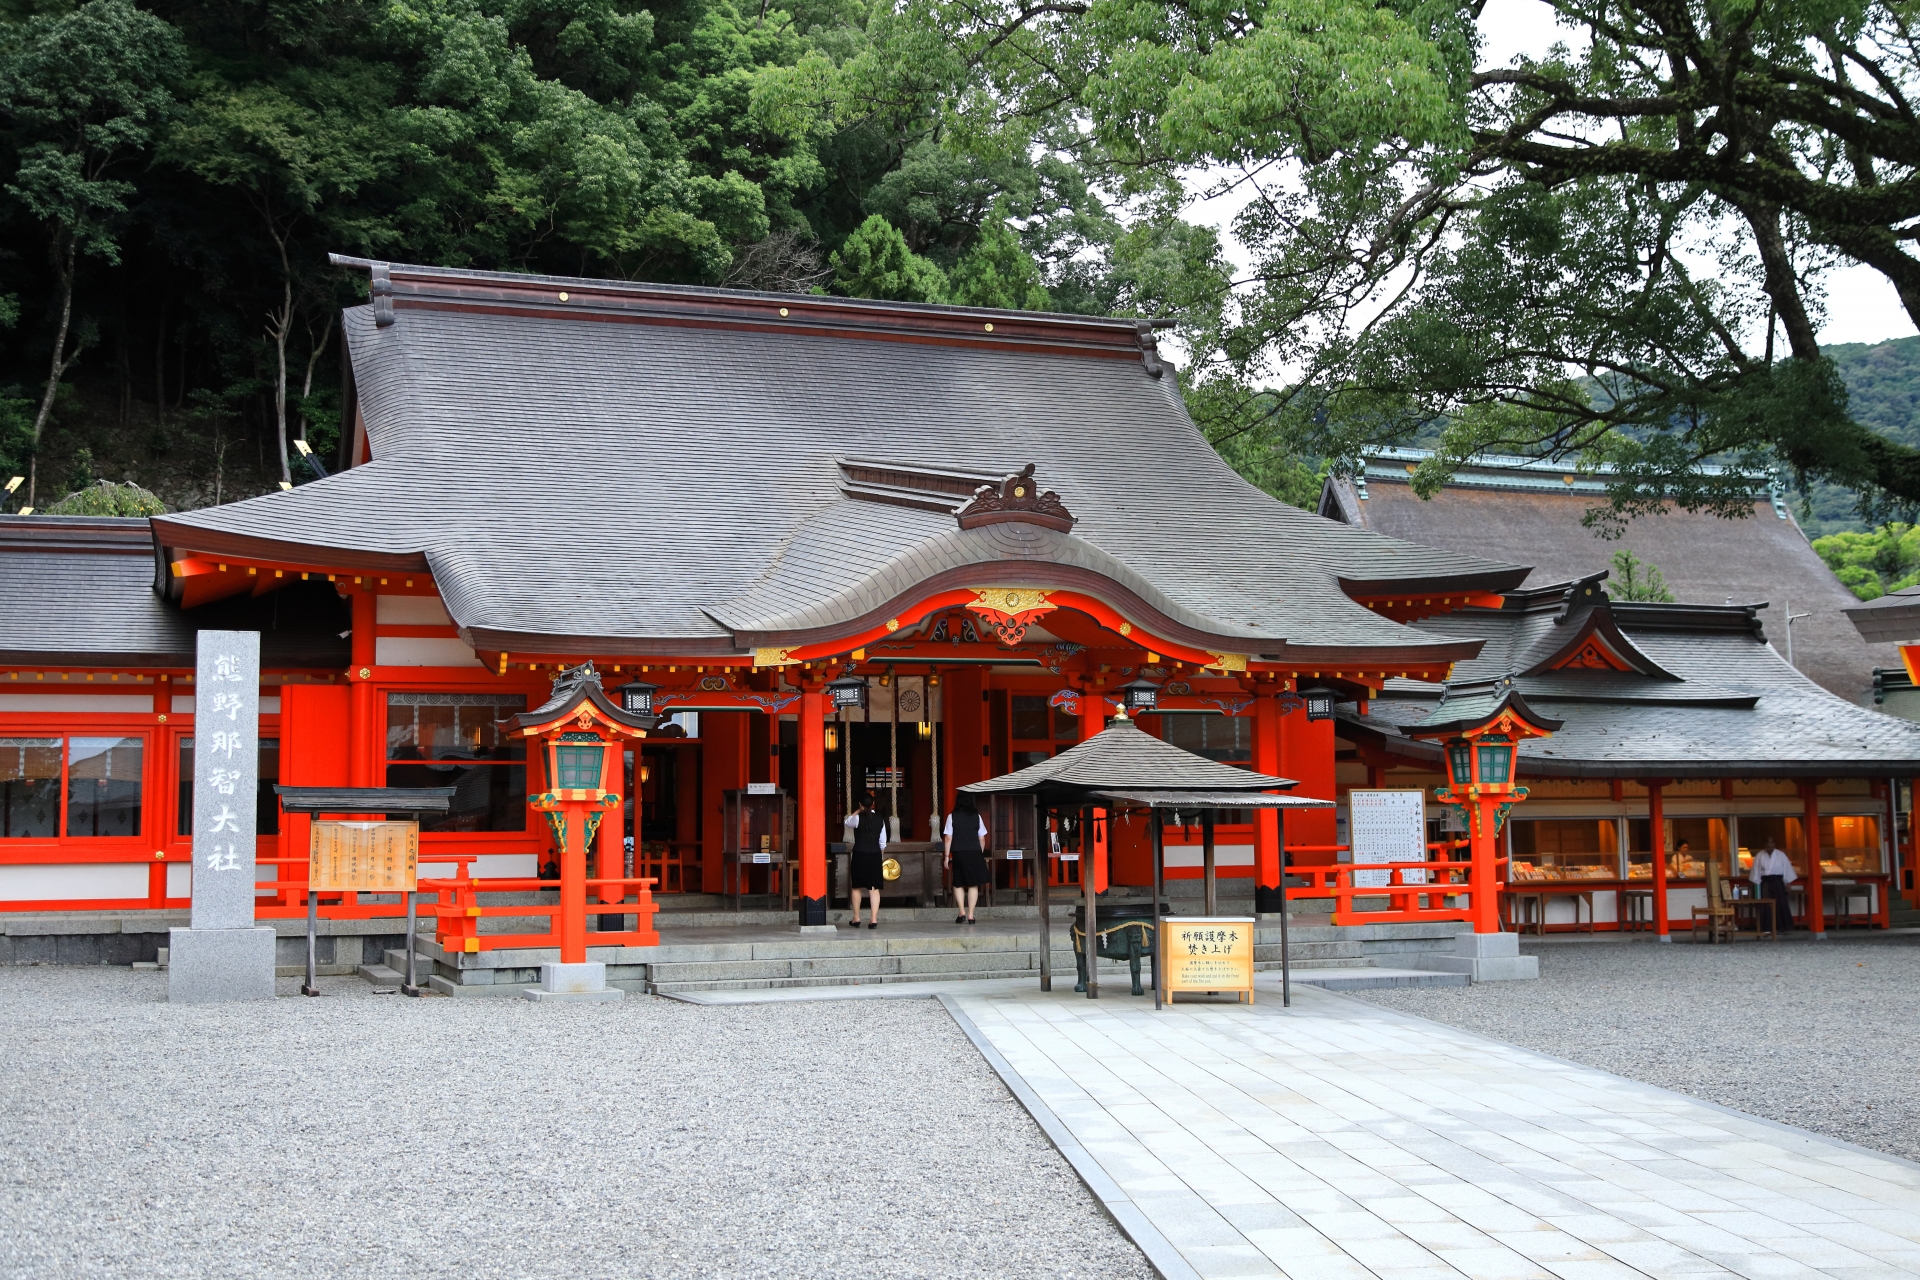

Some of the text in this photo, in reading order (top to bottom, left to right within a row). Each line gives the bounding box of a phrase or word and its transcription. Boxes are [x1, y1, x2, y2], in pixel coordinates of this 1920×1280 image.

[207, 653, 244, 872] 熊野那智大社
[1181, 930, 1239, 942] 祈願護摩木
[1188, 944, 1233, 955] 焚き上げ
